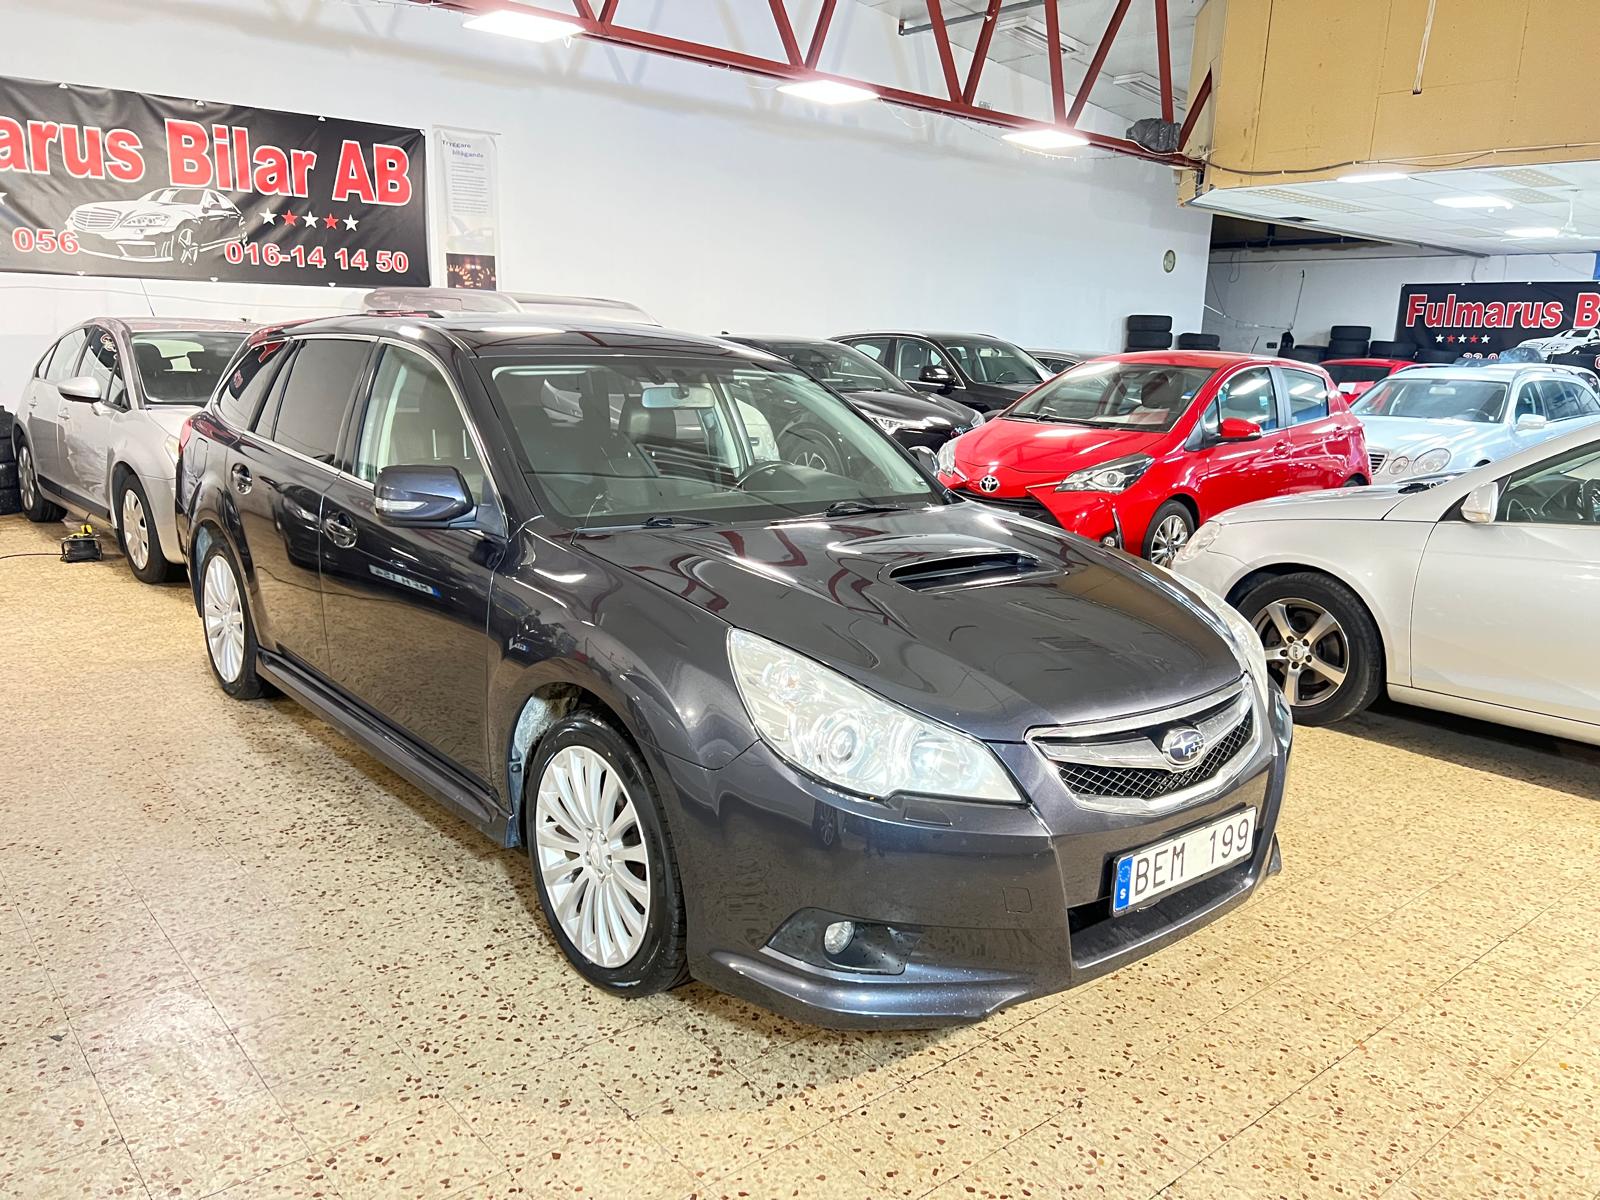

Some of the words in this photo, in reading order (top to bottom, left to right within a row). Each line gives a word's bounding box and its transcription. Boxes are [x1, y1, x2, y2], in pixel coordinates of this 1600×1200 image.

[0, 116, 145, 182] arus
[164, 118, 317, 198] Bilar
[332, 140, 412, 206] AB
[12, 227, 80, 254] 056
[225, 241, 326, 268] 016-14
[335, 248, 368, 271] 14
[376, 251, 409, 273] 50
[1405, 294, 1564, 328] Fulmarus
[1573, 293, 1600, 329] B
[1135, 842, 1185, 896] BEM
[1210, 818, 1249, 865] 199
[1120, 888, 1127, 900] S
